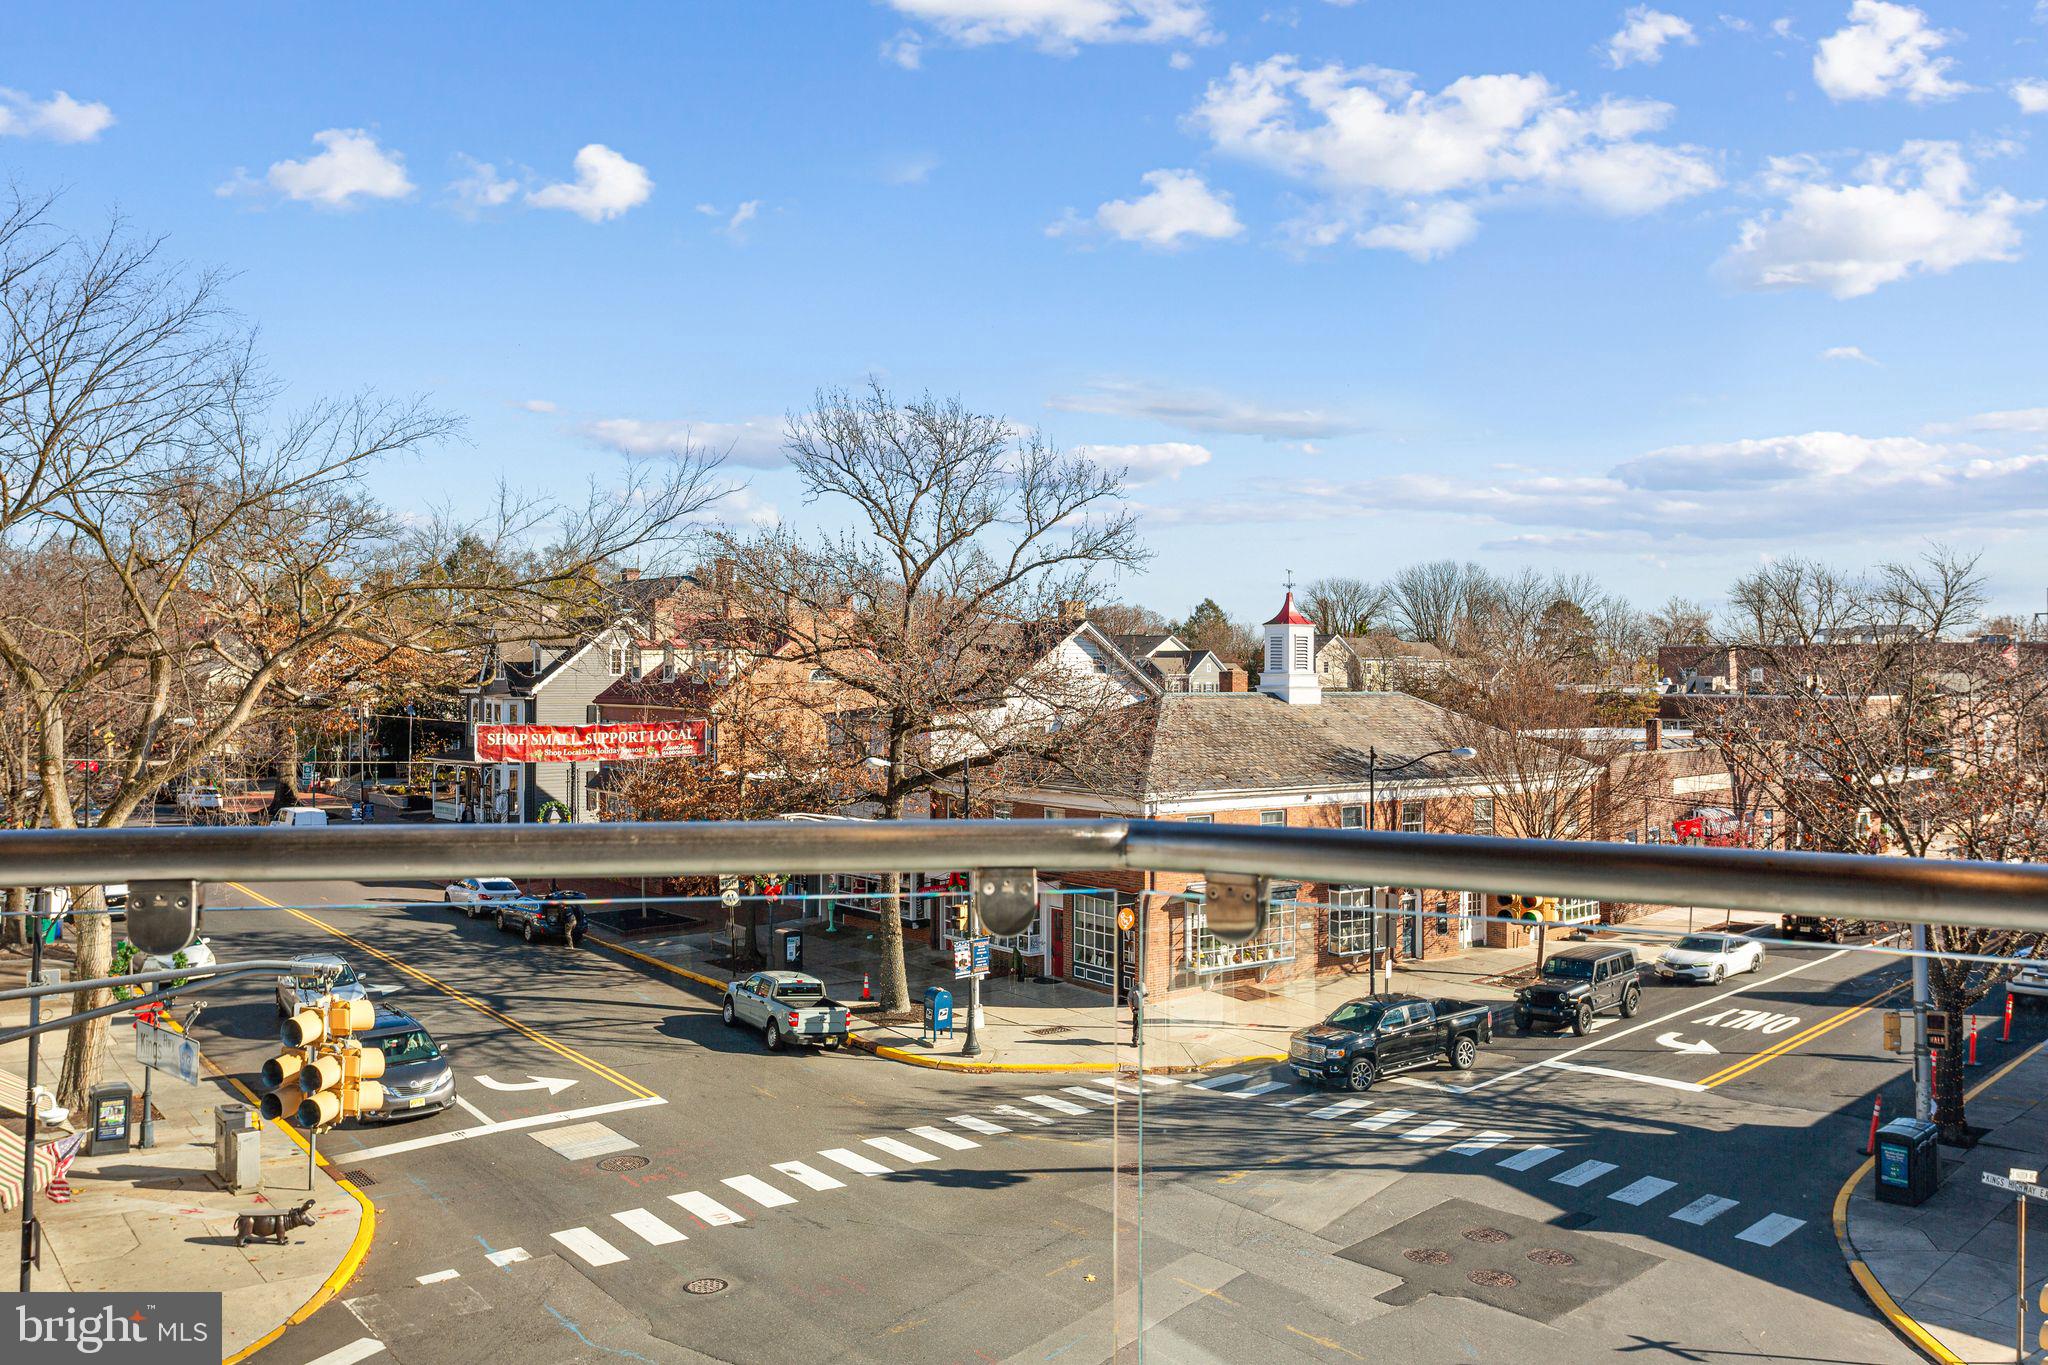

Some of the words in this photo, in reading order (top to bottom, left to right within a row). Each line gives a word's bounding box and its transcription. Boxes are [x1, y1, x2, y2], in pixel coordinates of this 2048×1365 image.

[487, 732, 527, 746] SHOP
[585, 730, 646, 745] SUPPORT
[649, 728, 697, 742] LOCAL.
[544, 749, 561, 757] Shop
[563, 748, 581, 756] Local
[1690, 1008, 1800, 1034] ONLY
[140, 1032, 162, 1067] Kings
[163, 1033, 176, 1052] Hwy
[1985, 1174, 2005, 1187] KINGS
[2008, 1180, 2037, 1195] HIGHWAY
